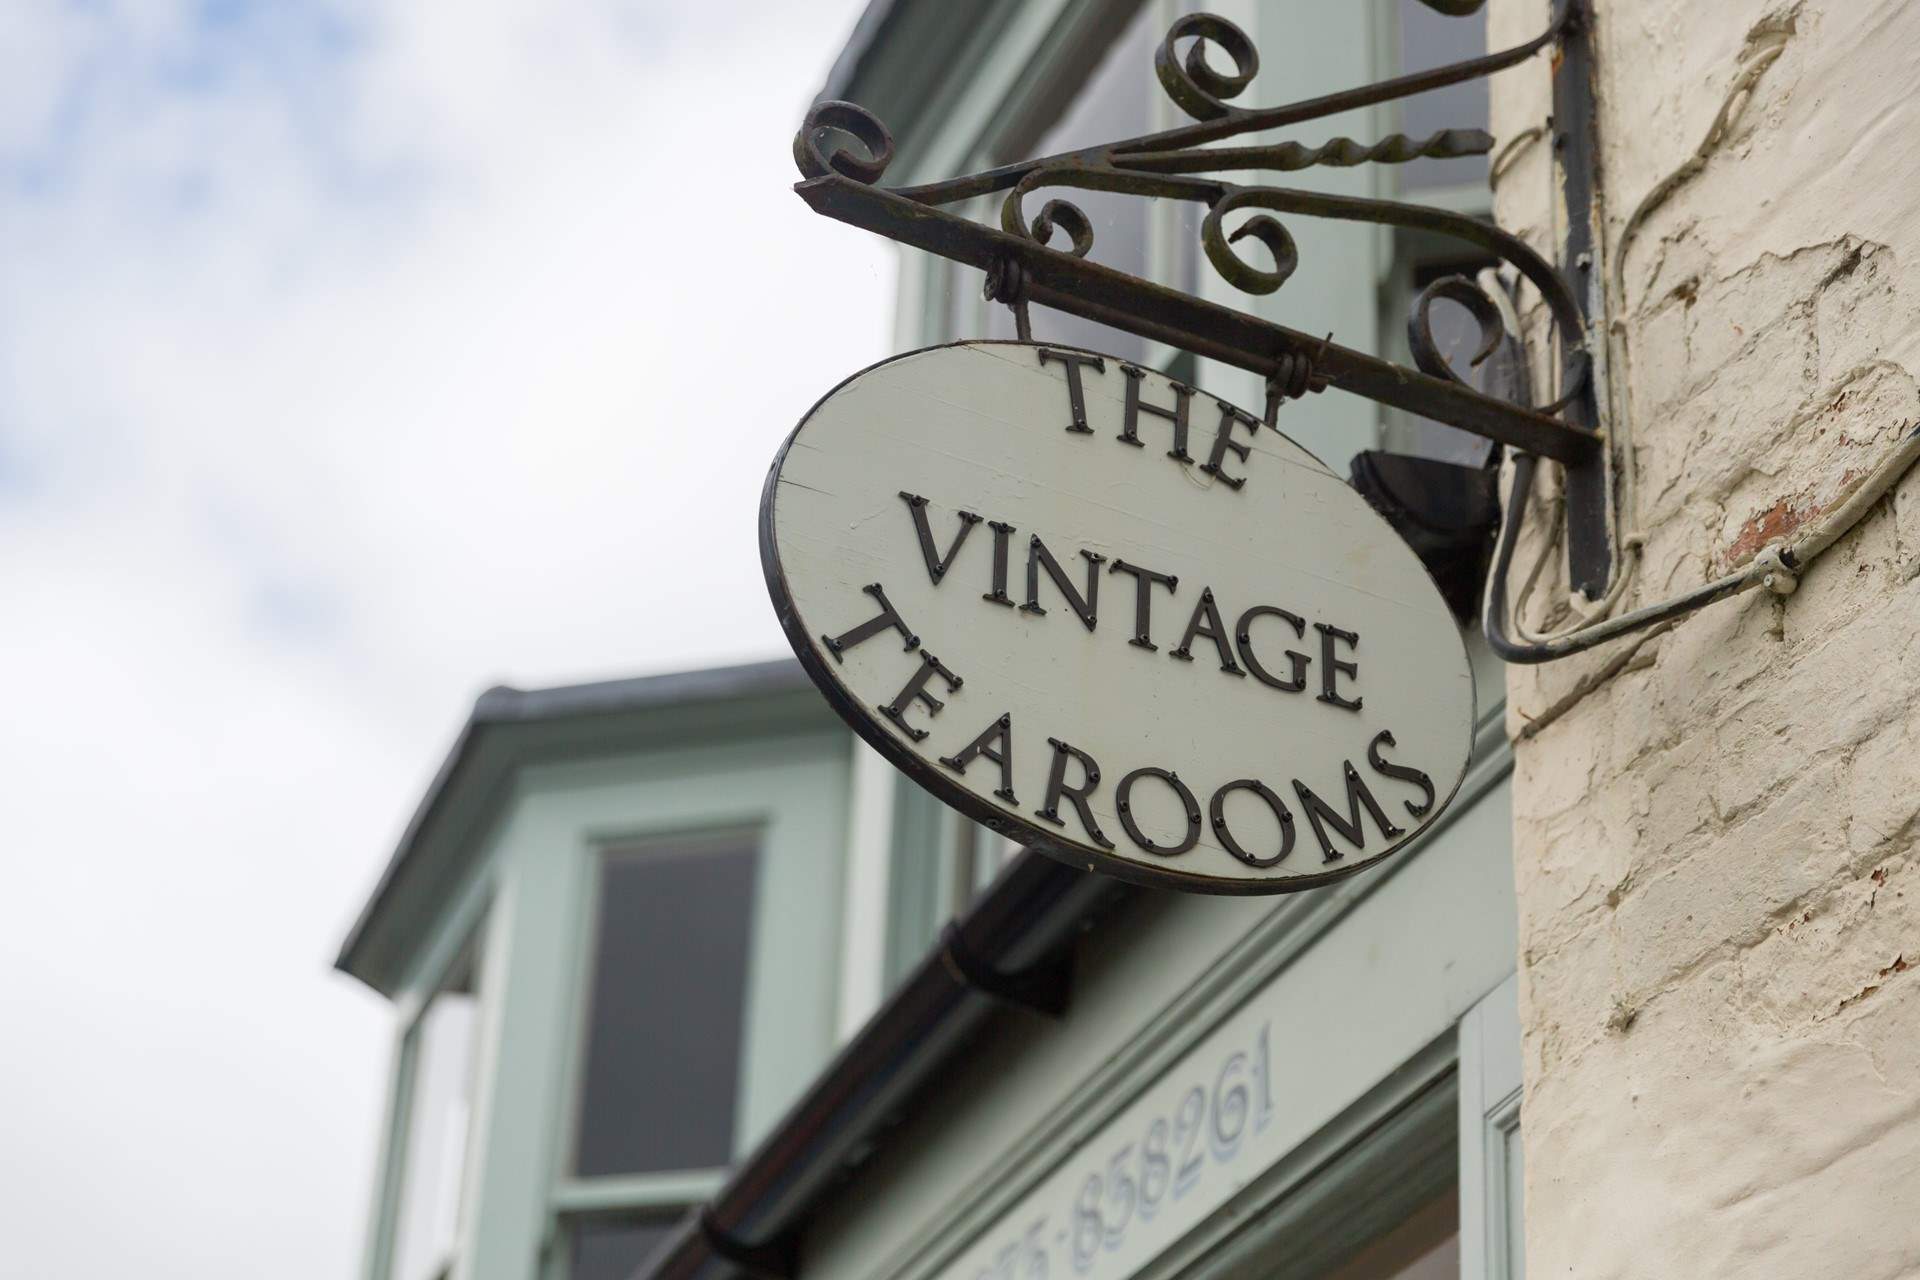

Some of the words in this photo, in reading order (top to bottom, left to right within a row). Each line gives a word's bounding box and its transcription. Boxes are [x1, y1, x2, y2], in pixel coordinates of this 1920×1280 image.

[1040, 348, 1259, 490] THE
[899, 491, 1364, 711] VINTAGE
[822, 583, 1435, 868] TEAROOMS
